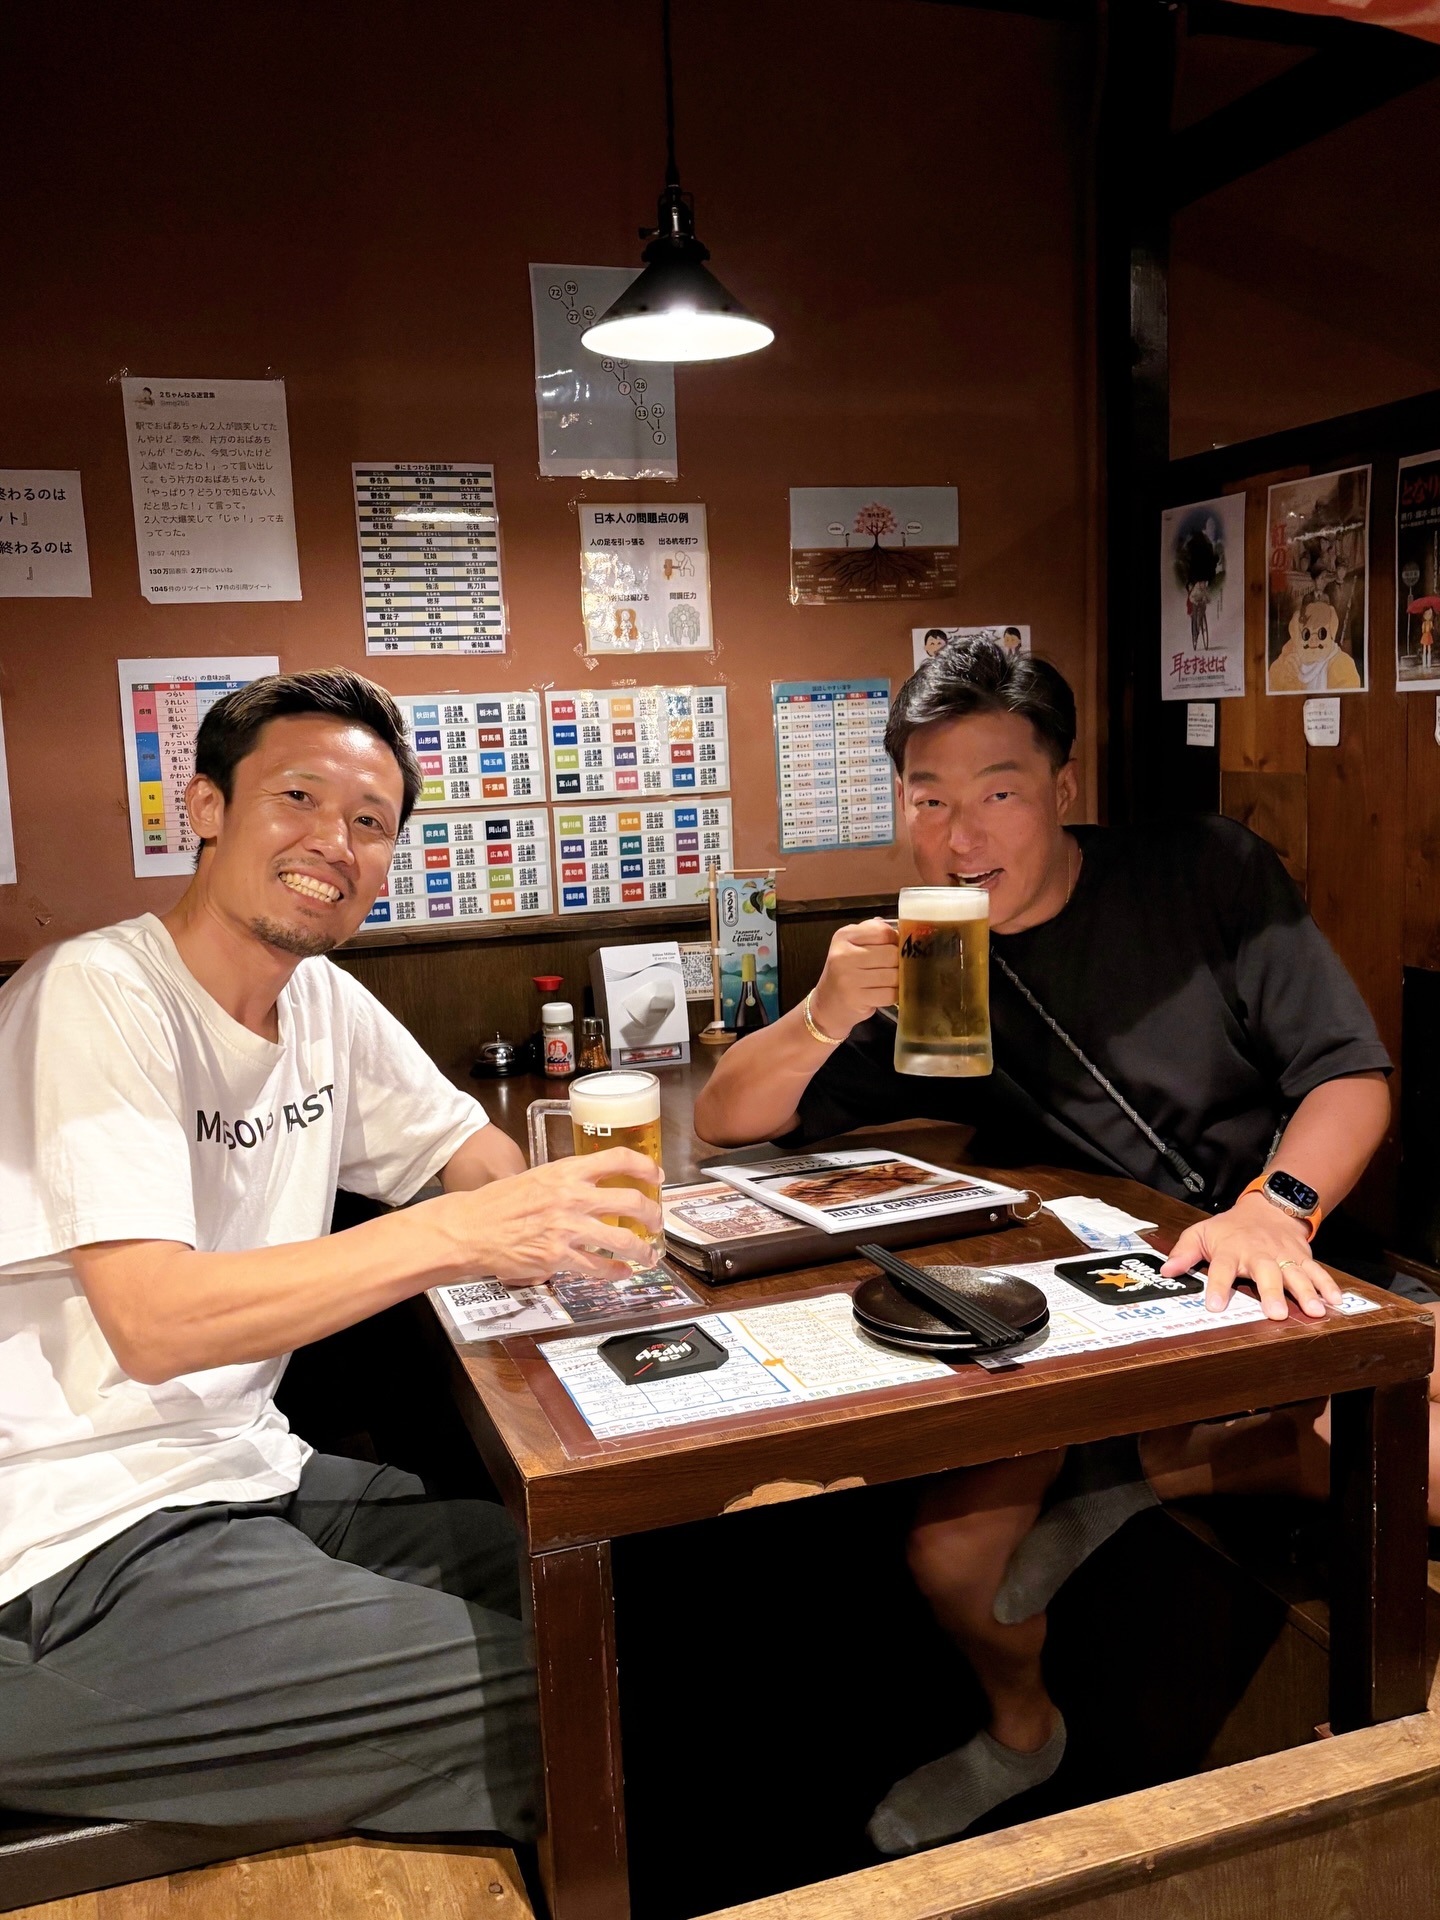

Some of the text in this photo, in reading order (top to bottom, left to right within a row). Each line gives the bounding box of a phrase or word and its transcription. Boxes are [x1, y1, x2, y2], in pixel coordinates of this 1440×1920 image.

[623, 384, 627, 392] ?
[594, 512, 689, 524] 日本人の問題点の例
[146, 529, 185, 537] ってった。
[590, 538, 645, 546] 人の足を引っ張る
[1270, 522, 1288, 592] 紅の
[1170, 652, 1228, 682] 耳をすませば
[484, 758, 502, 766] 埼玉県
[488, 826, 508, 834] 岡山県
[622, 841, 640, 849] 長崎県
[624, 888, 642, 896] 大分県
[431, 903, 451, 911] 島根県
[830, 1203, 882, 1219] Menu
[635, 1342, 692, 1361] Asahi
